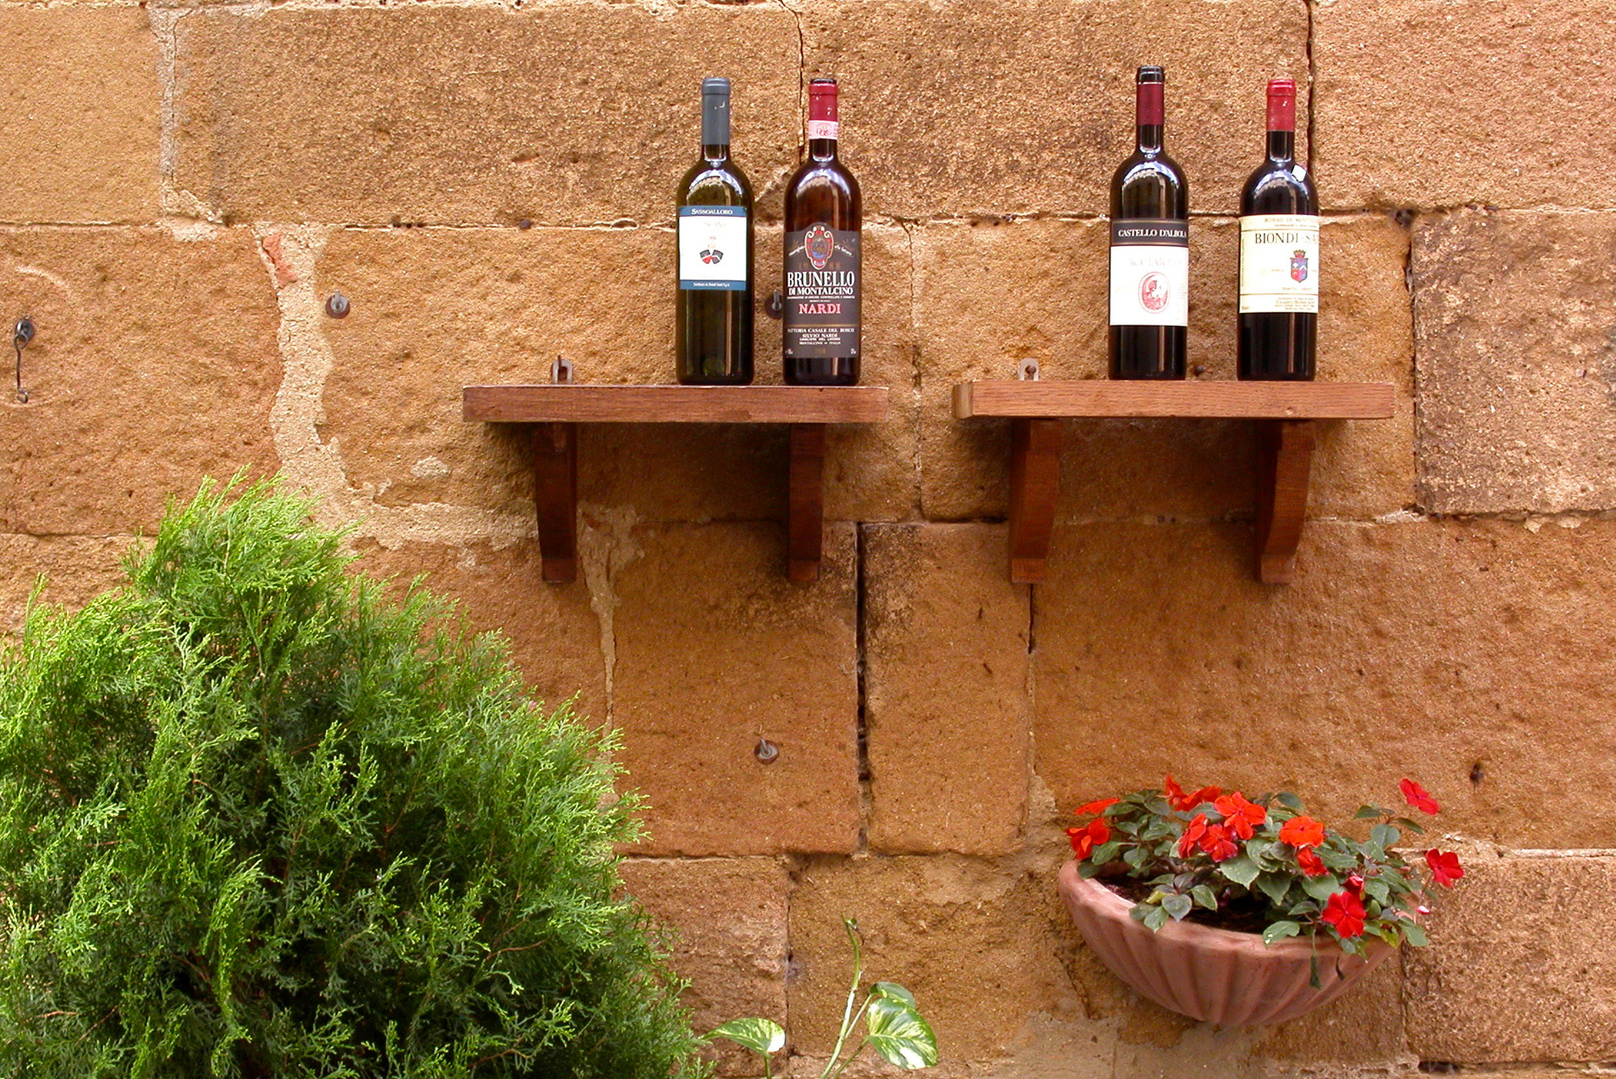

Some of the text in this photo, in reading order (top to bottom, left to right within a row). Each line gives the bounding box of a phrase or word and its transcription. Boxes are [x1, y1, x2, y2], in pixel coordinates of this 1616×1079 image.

[1118, 229, 1157, 237] CASTELLO
[787, 271, 855, 287] BRUNELLO
[788, 287, 854, 296] DI MONTALCINO
[798, 303, 841, 315] NARDI
